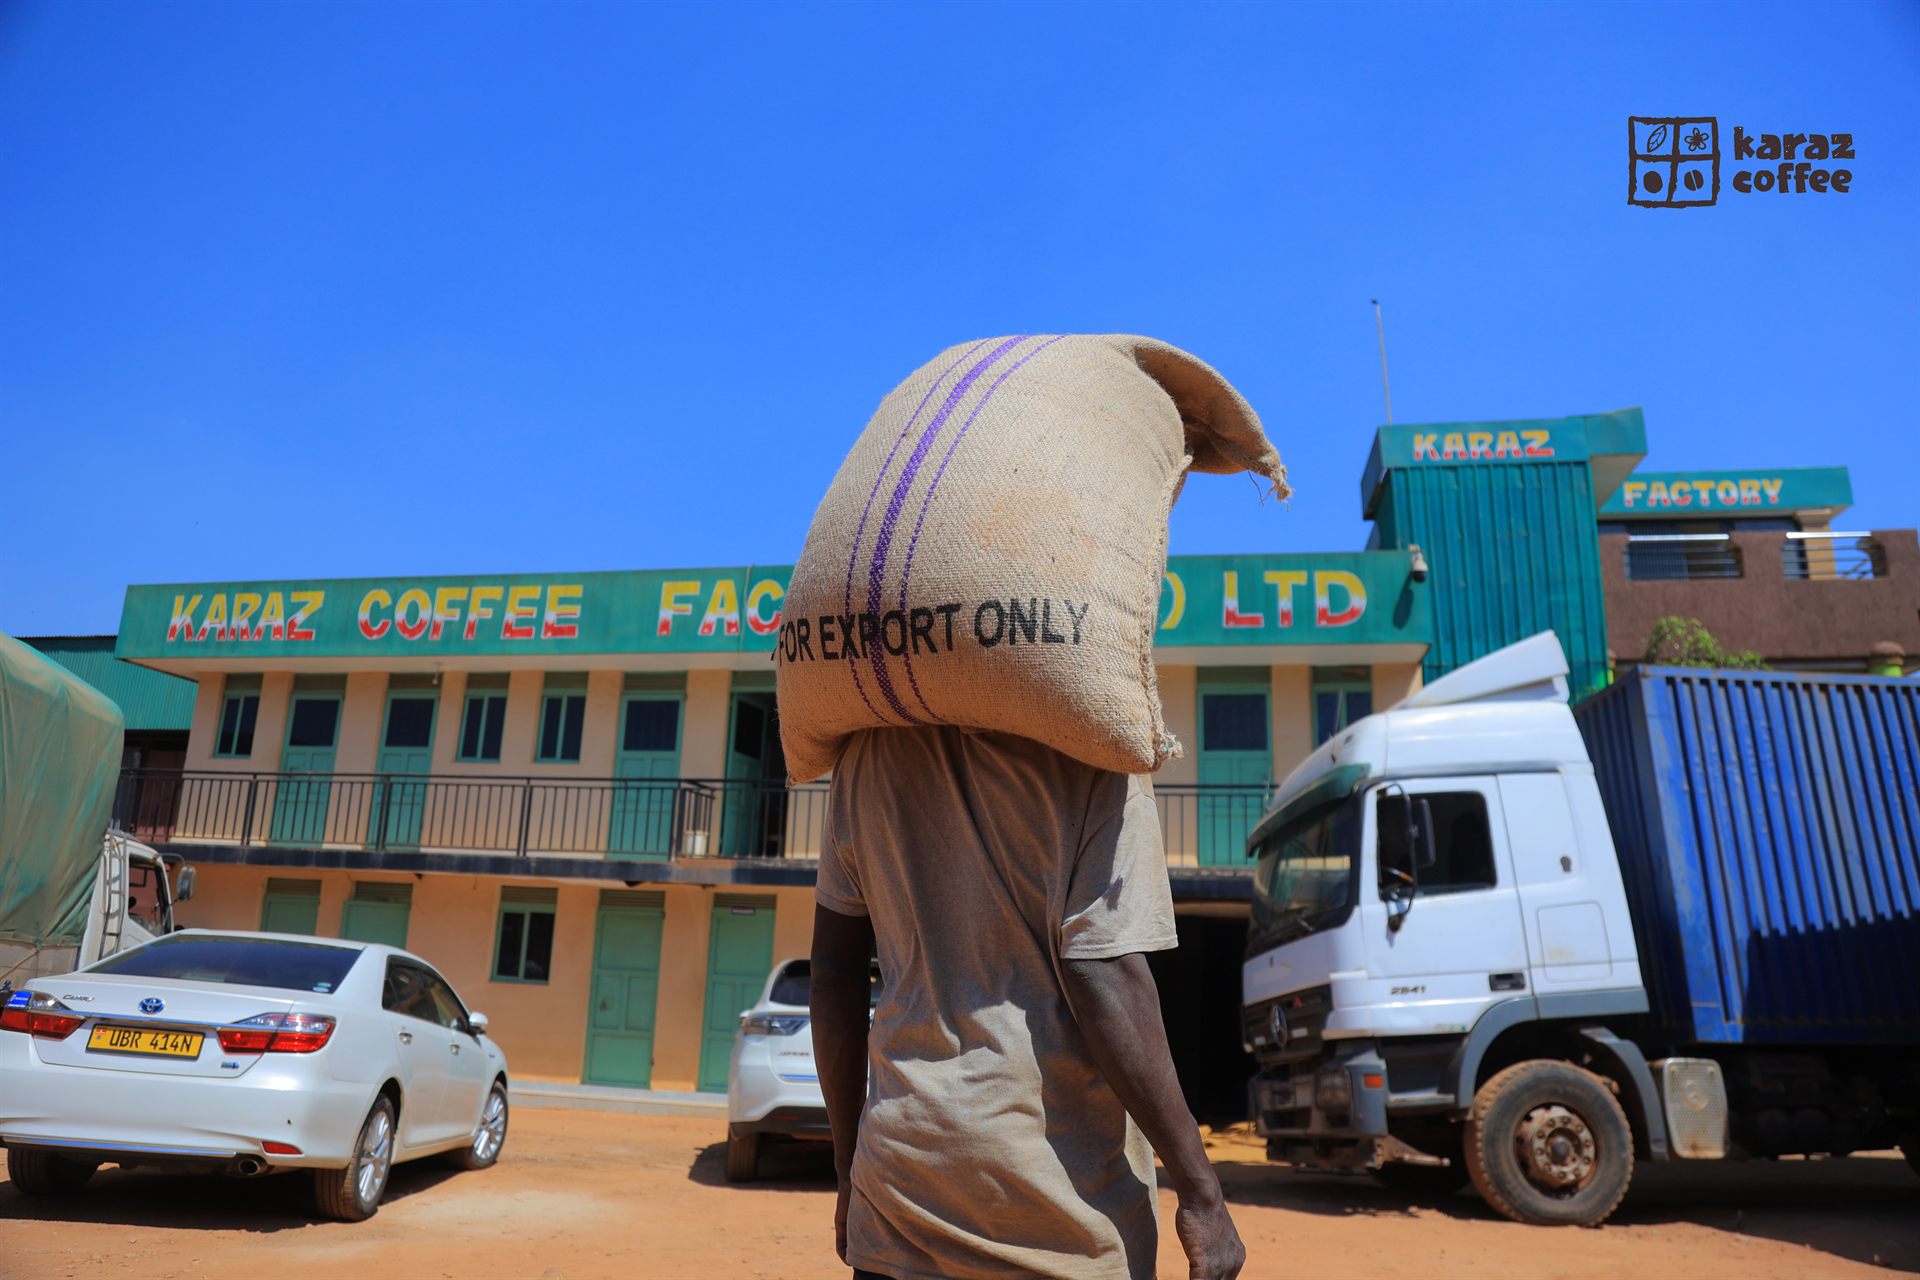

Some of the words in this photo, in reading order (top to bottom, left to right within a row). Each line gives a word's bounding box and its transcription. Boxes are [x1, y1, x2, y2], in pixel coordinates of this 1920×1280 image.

[1414, 430, 1555, 461] KARAZ
[1623, 479, 1783, 507] FACTORY
[166, 591, 325, 642] KARAZ
[358, 585, 583, 640] COFFEE
[1223, 570, 1367, 628] LTD
[778, 617, 815, 667] FOR
[819, 603, 962, 661] EXPORT
[974, 598, 1090, 648] ONLY
[110, 1028, 142, 1048] UBR
[150, 1032, 193, 1053] 414N
